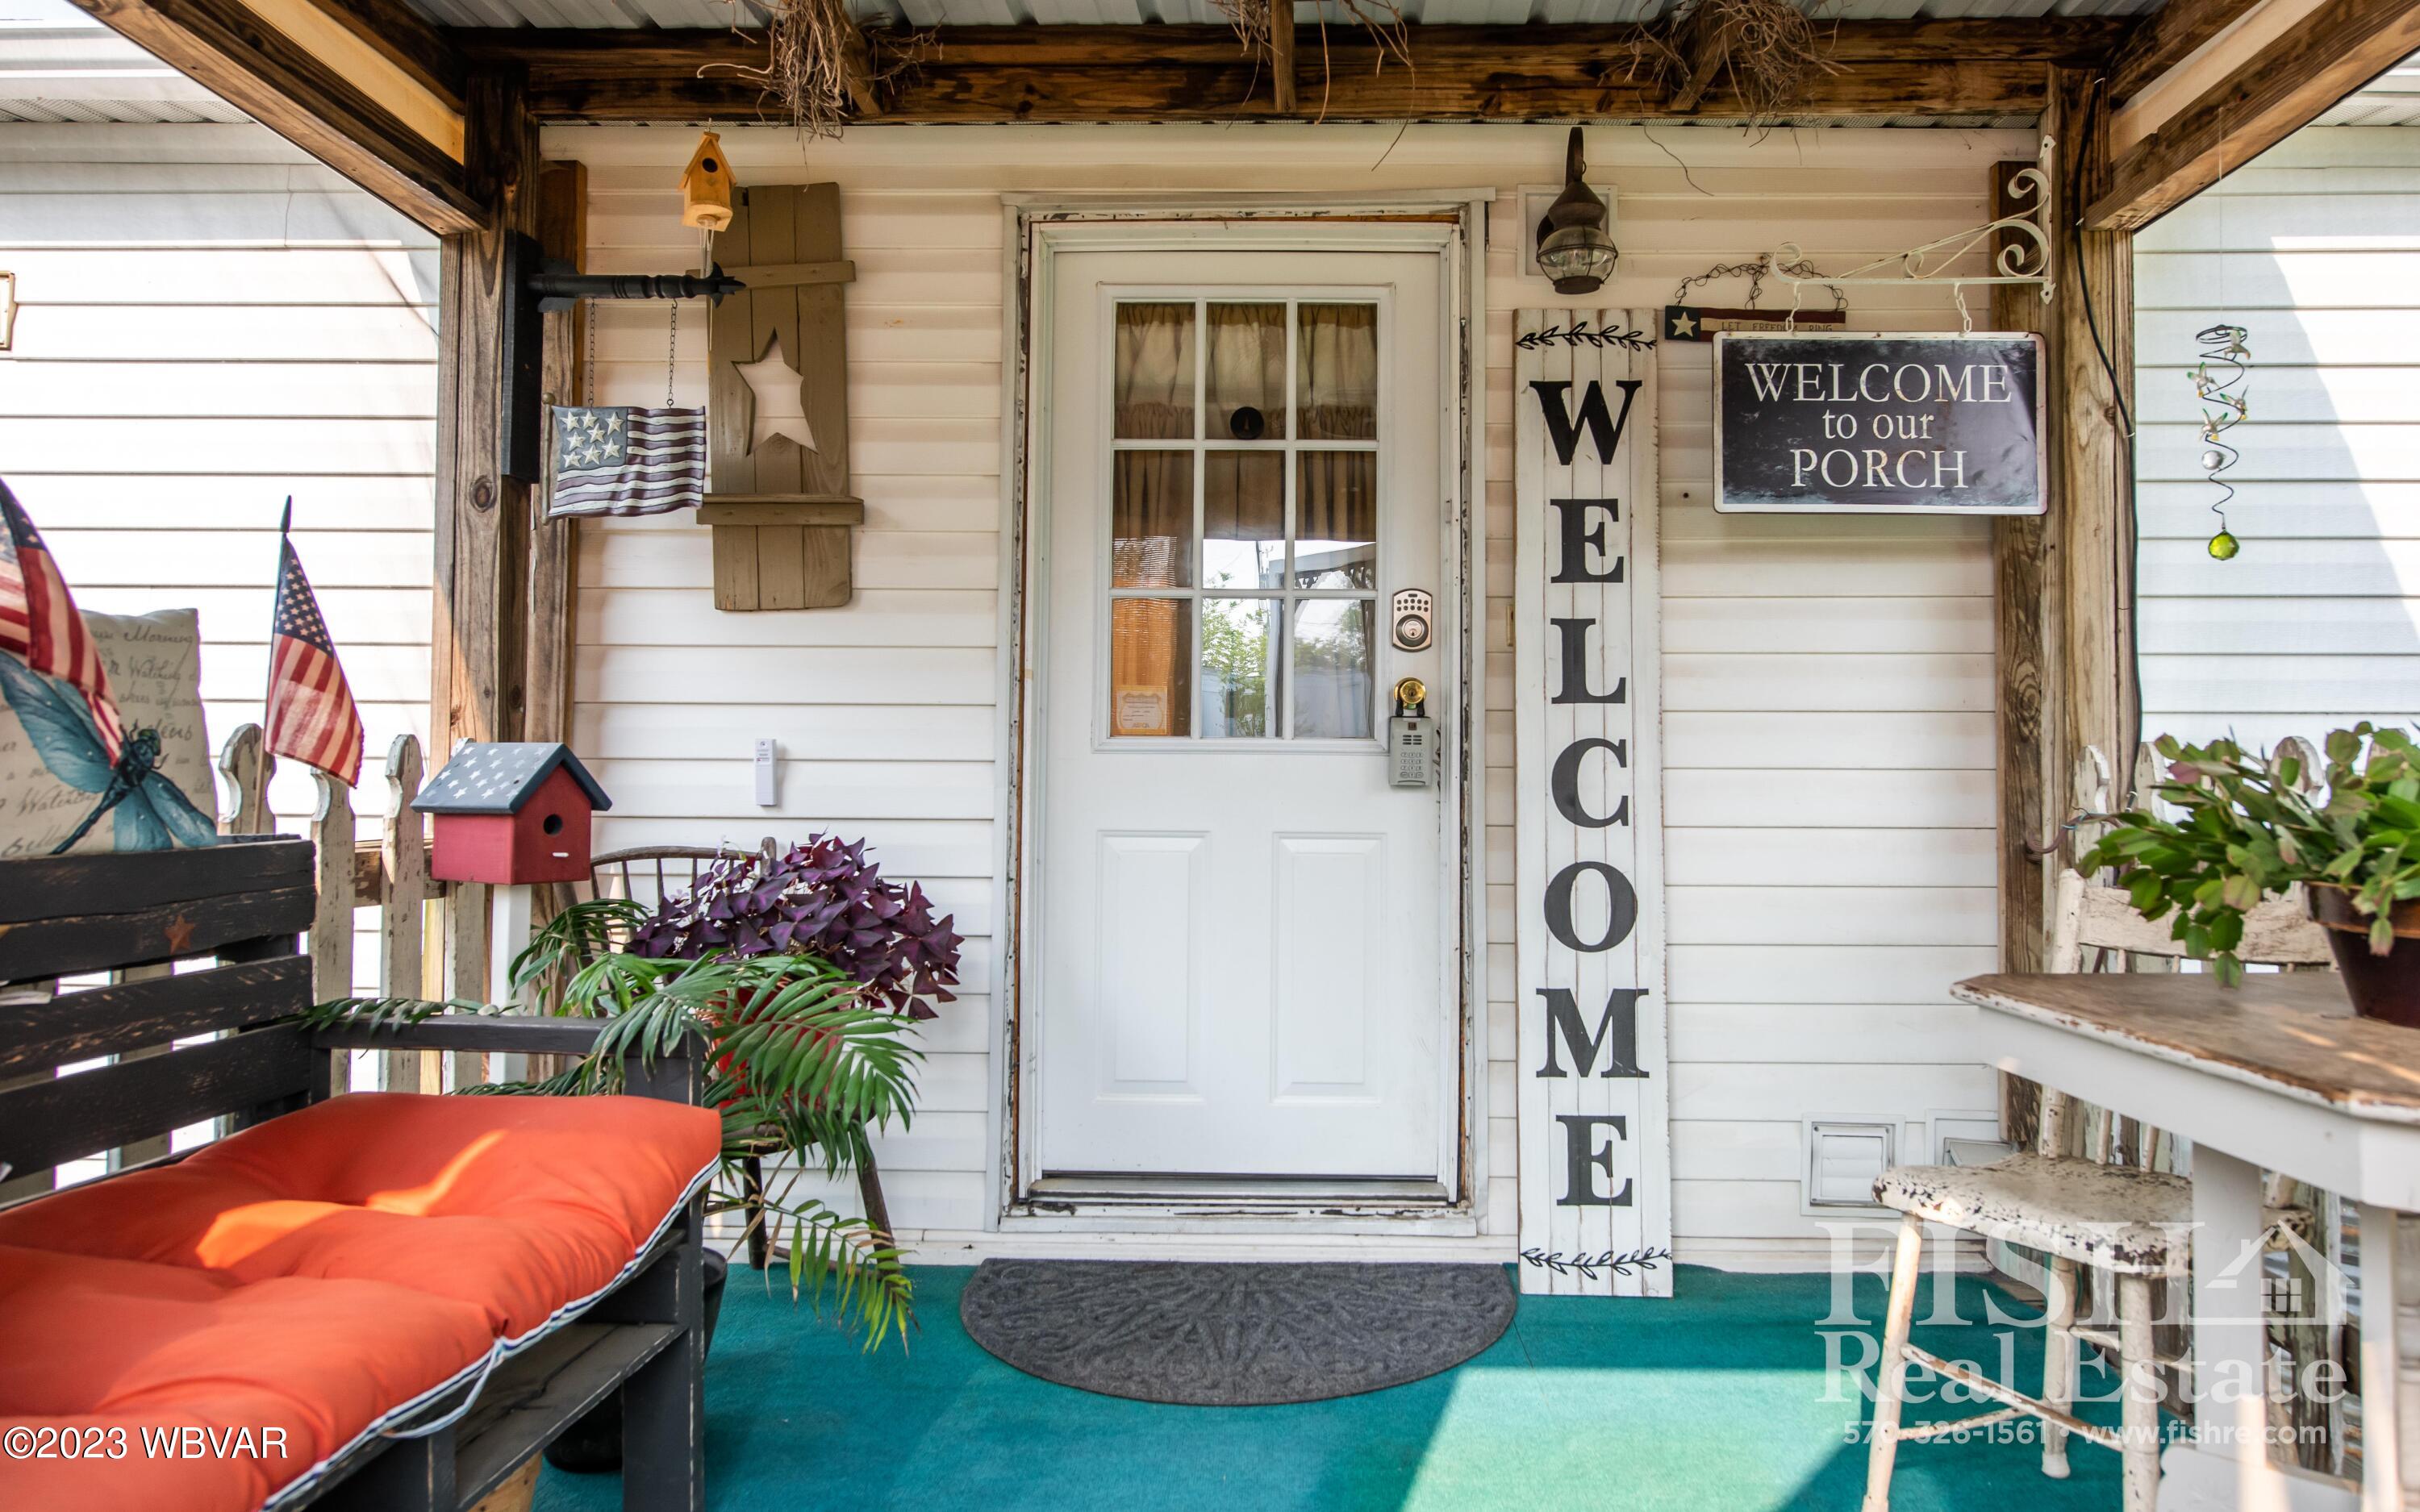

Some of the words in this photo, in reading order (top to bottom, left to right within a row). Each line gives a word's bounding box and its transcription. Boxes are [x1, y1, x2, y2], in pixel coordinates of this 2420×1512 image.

[1721, 322, 1740, 331] LET
[1744, 363, 2013, 402] WELCOME
[1822, 409, 1858, 439] to
[1872, 413, 1934, 439] our
[1789, 448, 1969, 488] PORCH
[1529, 380, 1650, 1207] WELCOME
